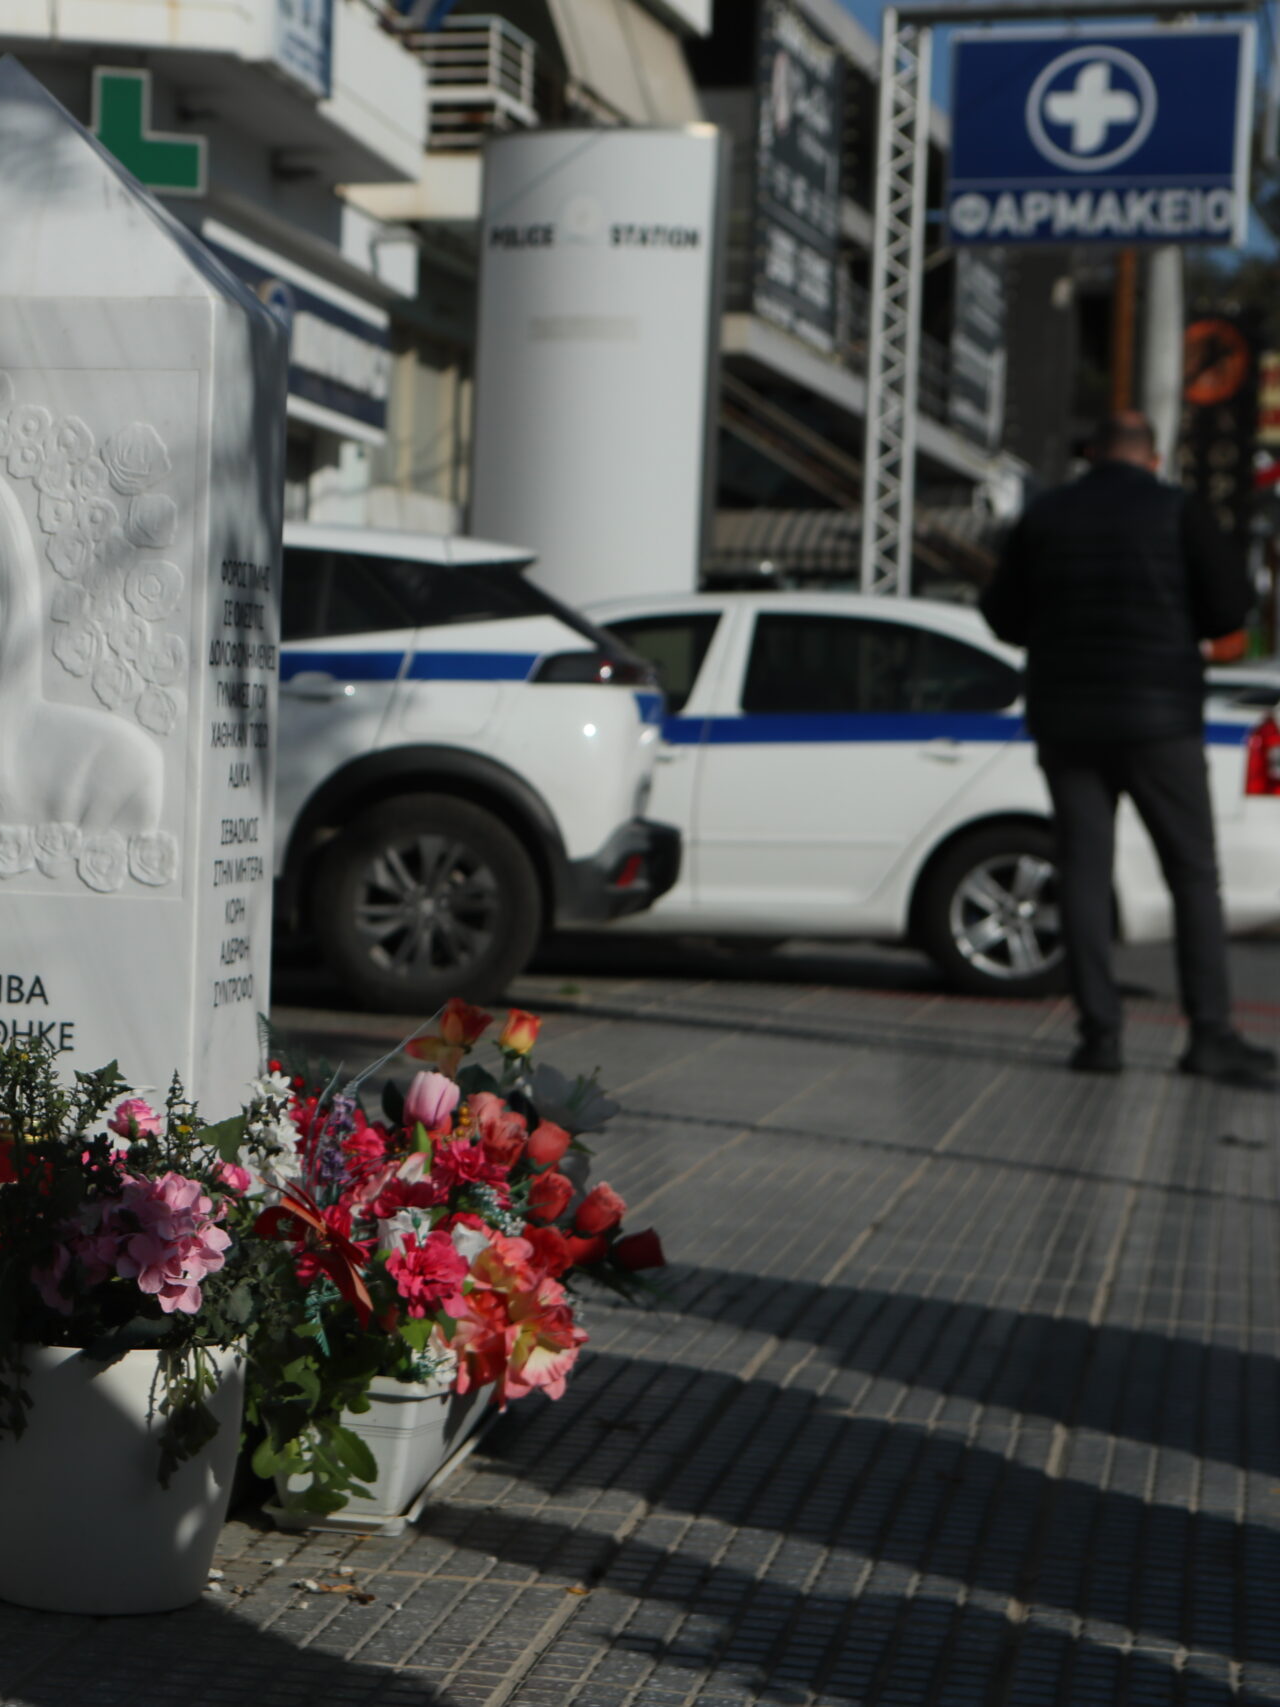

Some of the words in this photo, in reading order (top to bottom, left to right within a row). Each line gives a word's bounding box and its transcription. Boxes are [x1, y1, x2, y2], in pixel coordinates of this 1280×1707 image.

[950, 190, 1234, 237] ΦΑΡΜΑΚΕΙΟ
[490, 224, 554, 248] POLICE
[611, 223, 699, 248] STATION
[209, 639, 276, 671] ΔΟΛΟΦΟΝΗΜΕΝΕΣ
[217, 680, 250, 709] ΓΥΝΑΙΚΕΣ
[211, 722, 248, 749] ΧΑΘΗΚΑΝ
[228, 762, 250, 788] ΑΔΙΚΑ
[221, 817, 259, 845] ΣΕΒΑΣΜΟΣ
[214, 858, 233, 887] ΣΤΗΝ
[235, 856, 264, 885] ΜΗΤΕΡΑ
[225, 897, 245, 925] ΚΟΡΗ
[220, 936, 250, 966] ΑΔΕΡΦΗ
[213, 973, 253, 1008] ΣΥΝΤΡΟΦΟ
